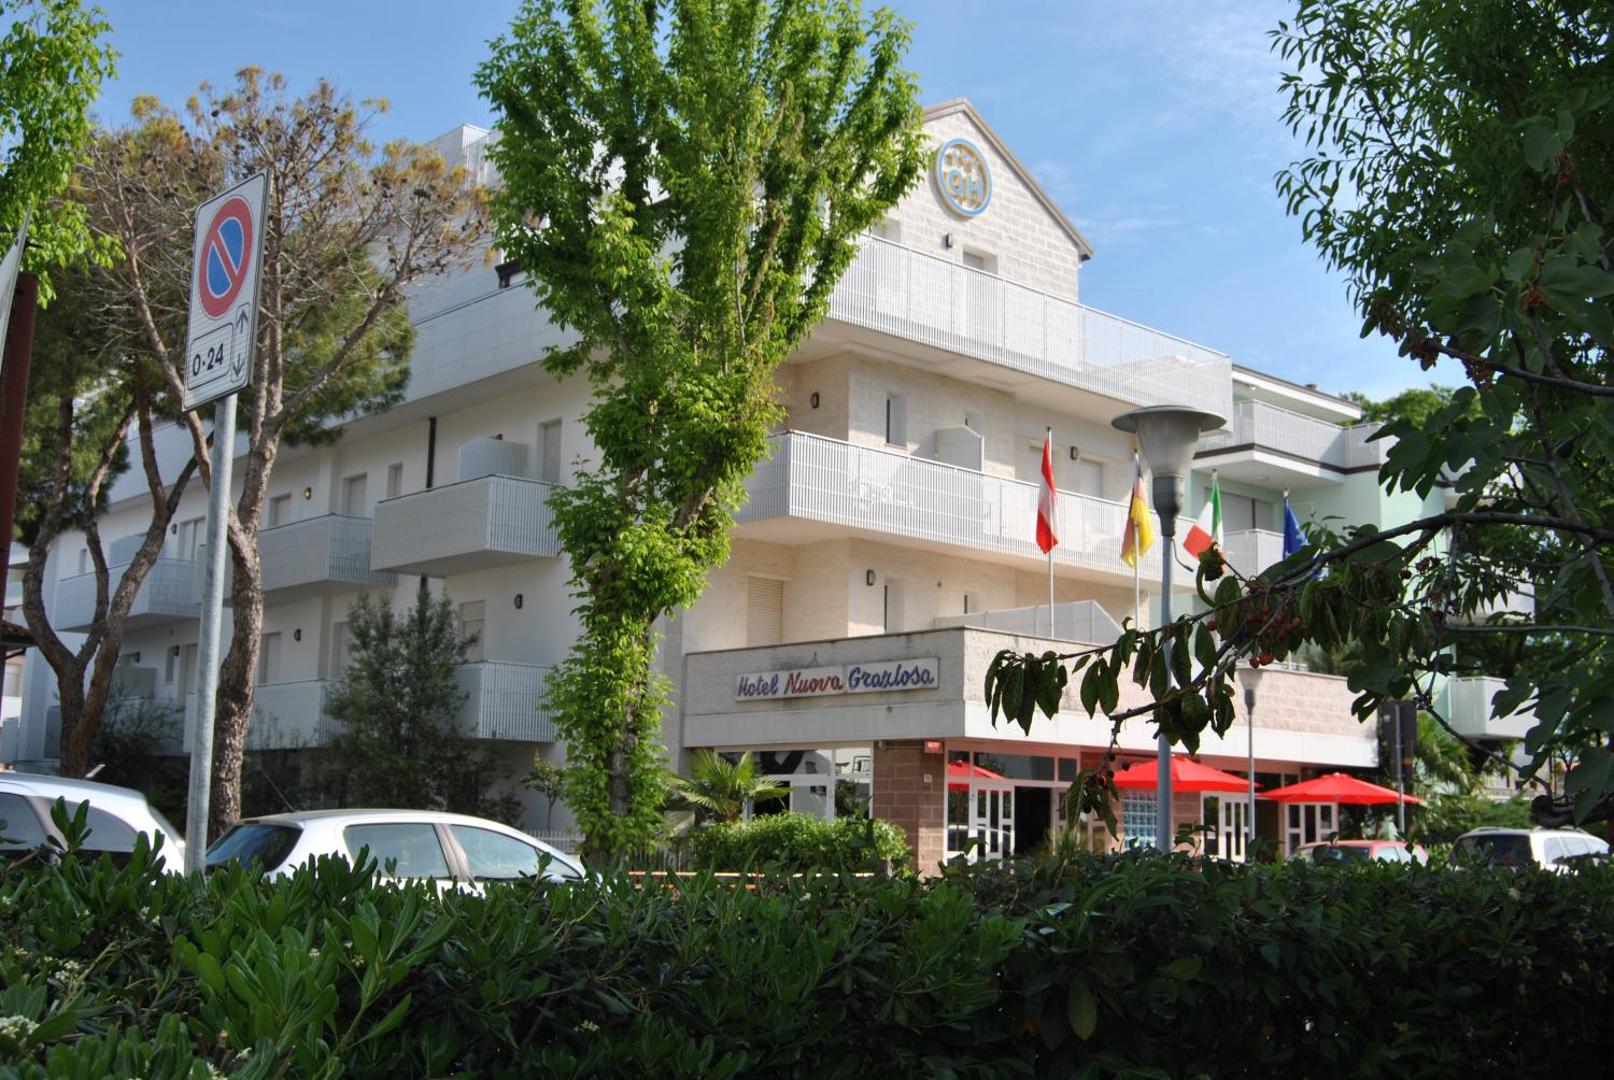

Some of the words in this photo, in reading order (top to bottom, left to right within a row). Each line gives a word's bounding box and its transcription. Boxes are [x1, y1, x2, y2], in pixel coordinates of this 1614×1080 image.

[192, 342, 224, 377] 0-24
[737, 673, 779, 697] Hotel
[784, 671, 844, 695] Nuova
